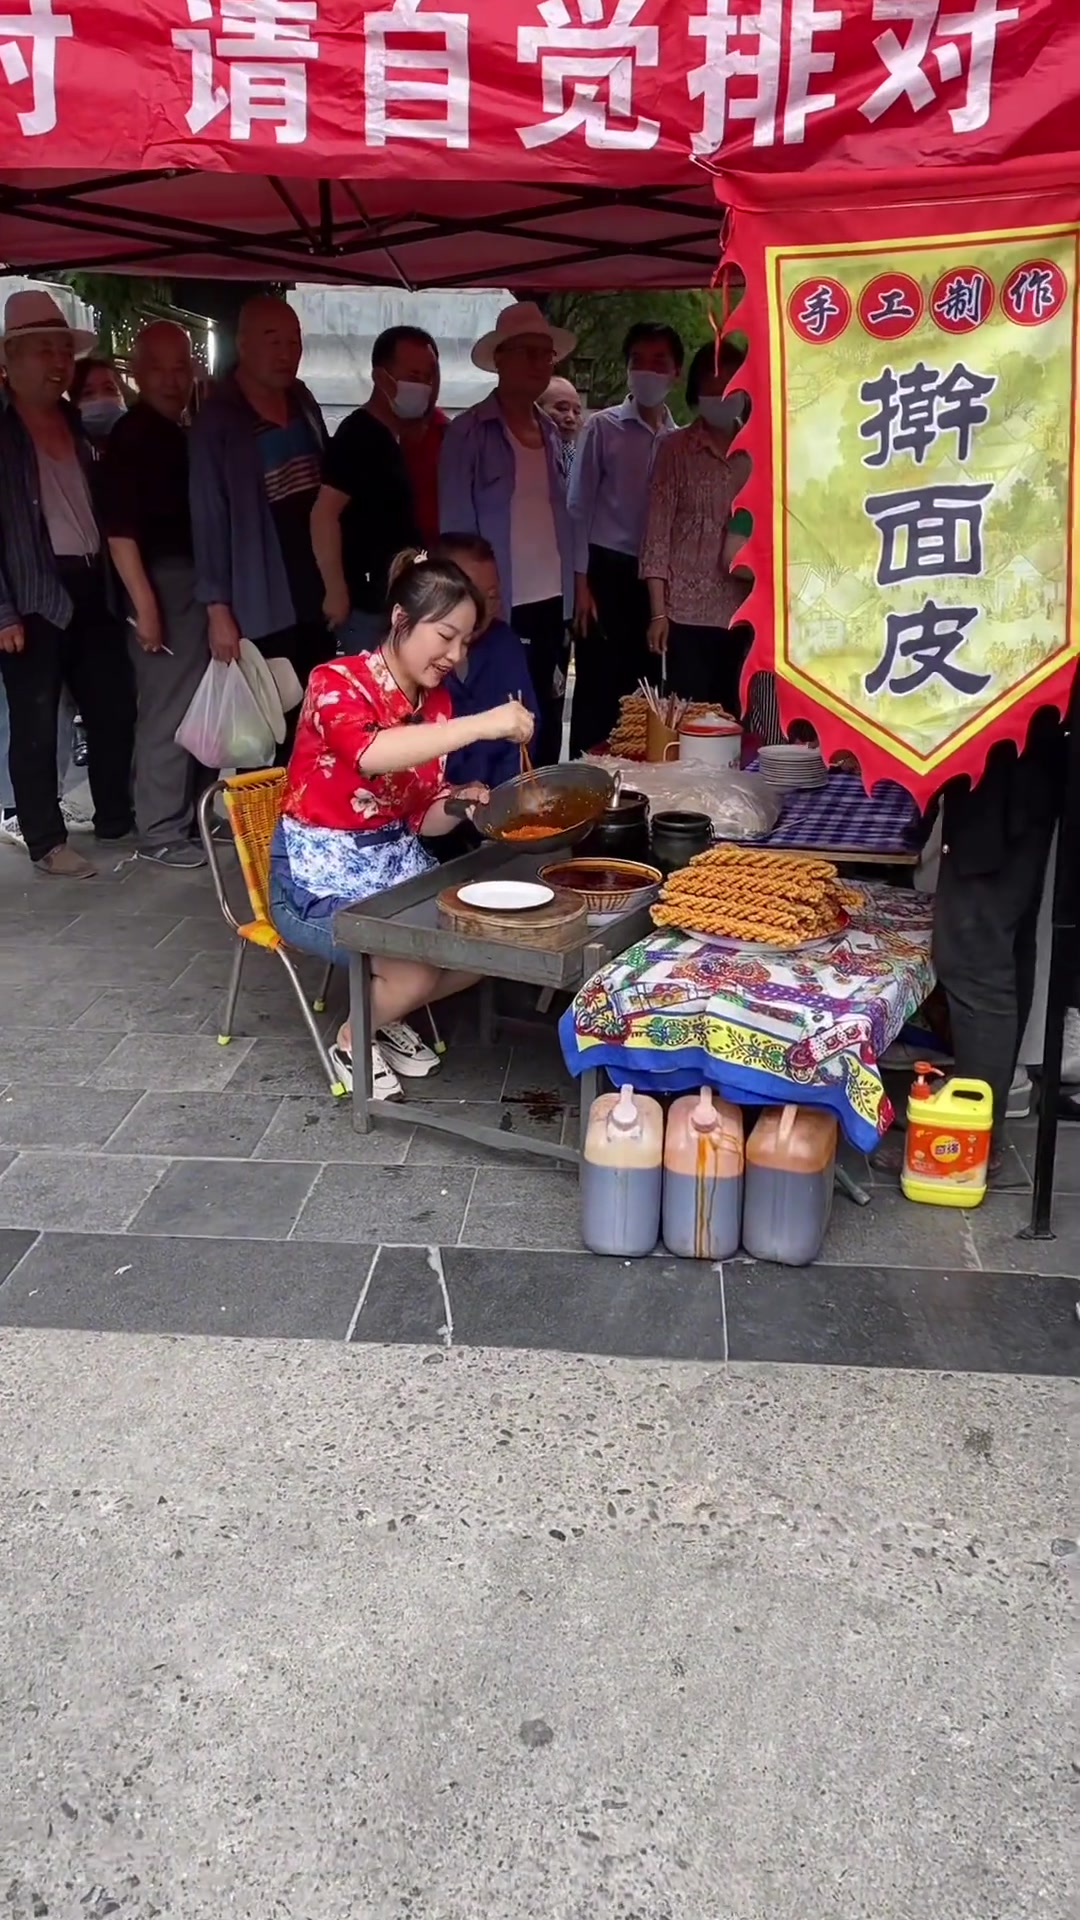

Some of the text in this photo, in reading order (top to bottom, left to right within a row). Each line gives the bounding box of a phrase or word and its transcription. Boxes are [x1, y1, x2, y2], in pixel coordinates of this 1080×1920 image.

[798, 268, 1055, 335] 手工制作
[859, 360, 997, 696] 擀面皮
